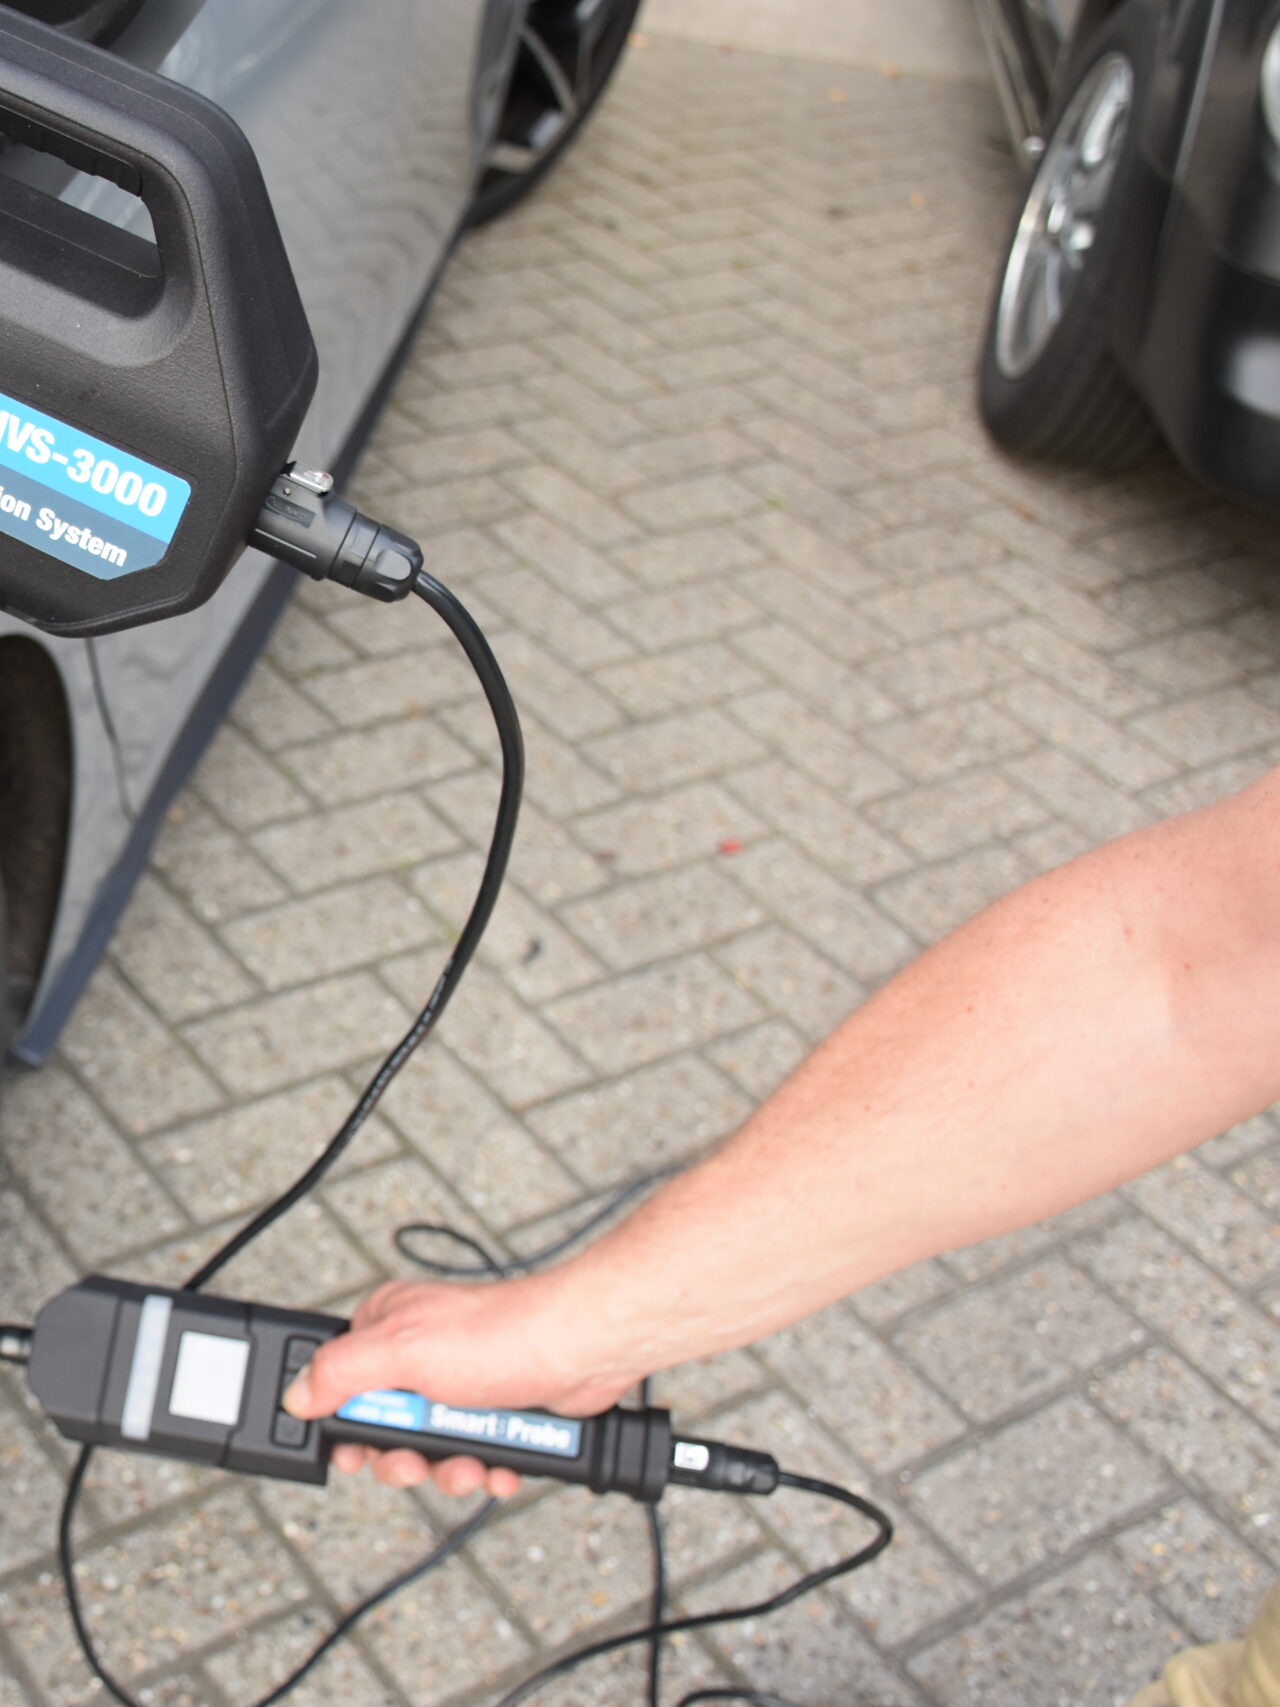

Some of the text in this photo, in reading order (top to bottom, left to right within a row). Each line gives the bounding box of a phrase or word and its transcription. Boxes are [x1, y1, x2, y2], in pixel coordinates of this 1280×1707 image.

[36, 507, 127, 567] System
[430, 1403, 497, 1437] Smart
[507, 1416, 572, 1449] Probe
